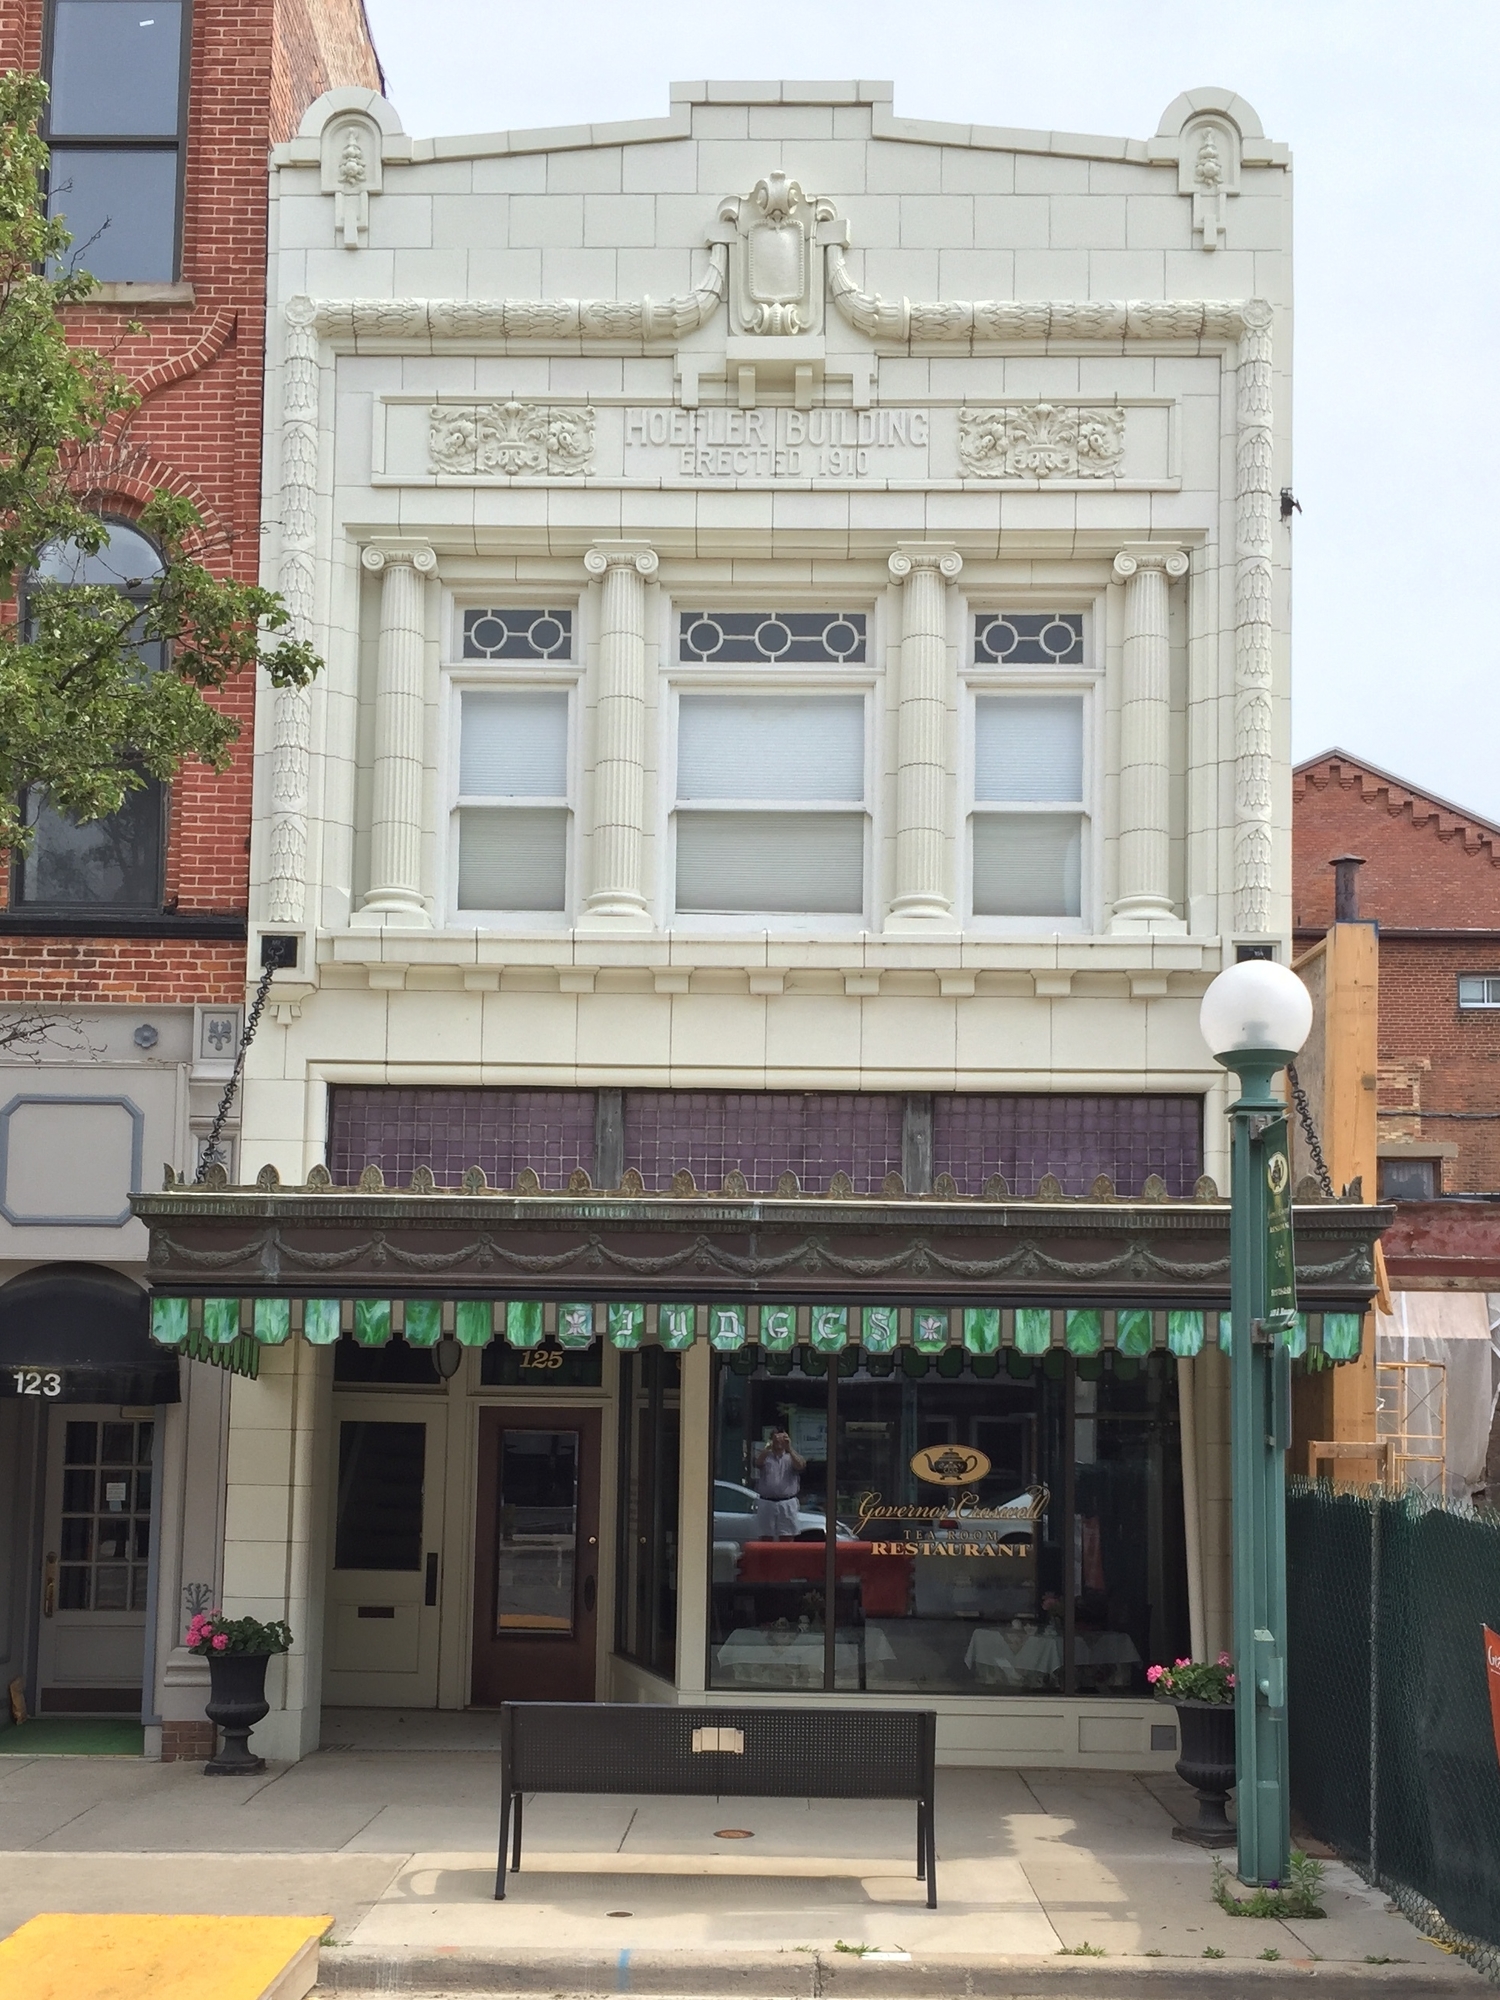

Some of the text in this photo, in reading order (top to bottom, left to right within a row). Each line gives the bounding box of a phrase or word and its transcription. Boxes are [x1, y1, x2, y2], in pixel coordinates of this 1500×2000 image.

[624, 409, 928, 448] HOEFLER BUILDING
[679, 450, 869, 477] ERECTED 1910
[519, 1350, 564, 1369] 125
[12, 1371, 61, 1397] 123
[852, 1484, 1051, 1535] Governor Croswell
[903, 1529, 1000, 1541] TEA ROOM
[870, 1541, 1033, 1558] RESTAURANT
